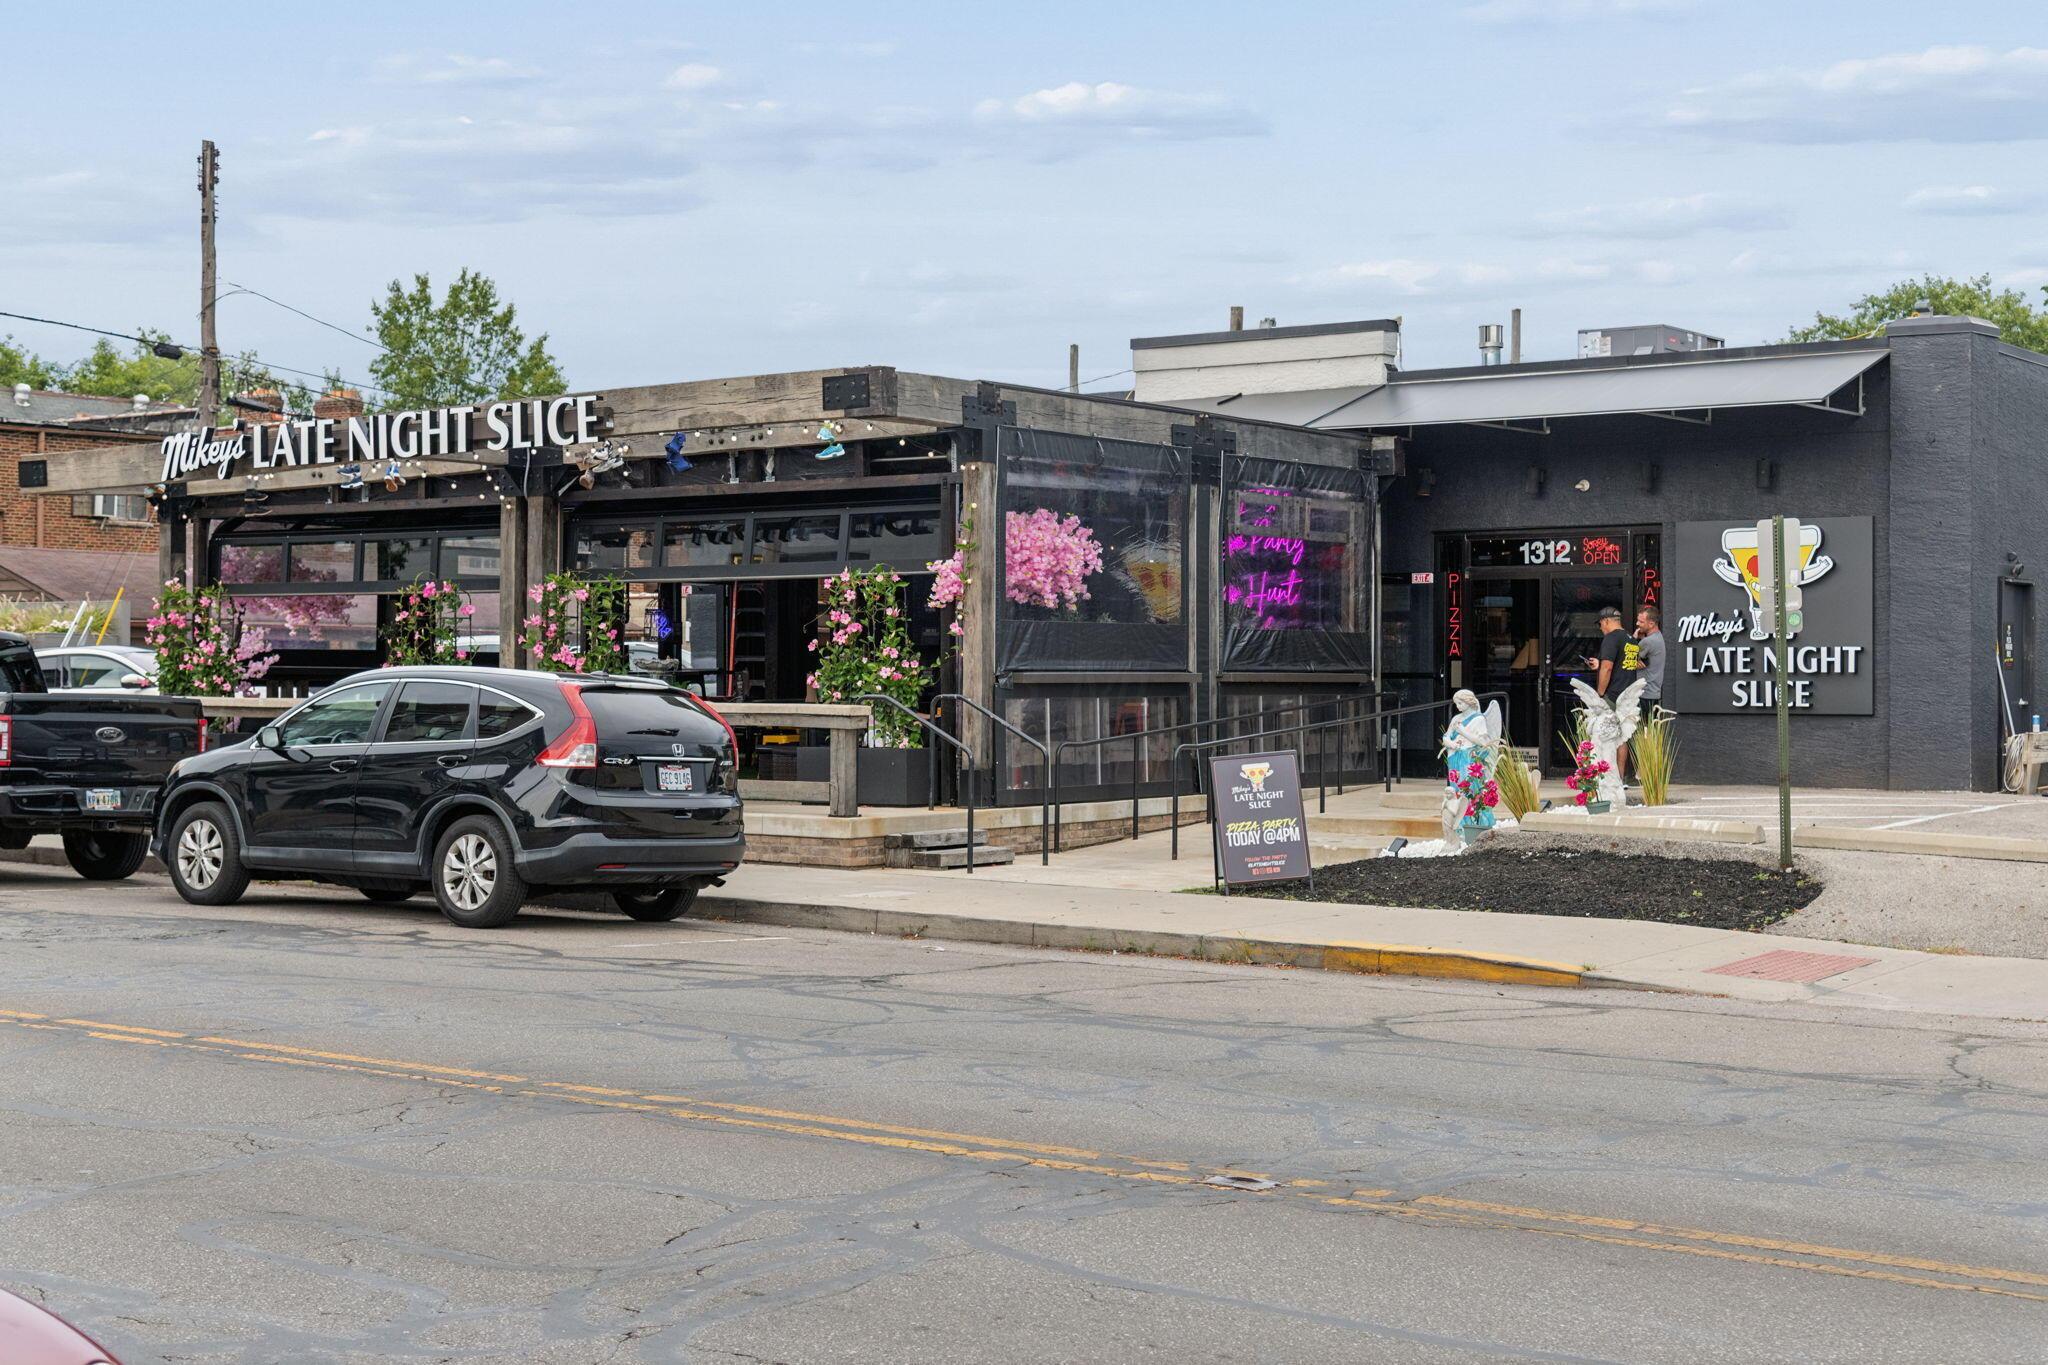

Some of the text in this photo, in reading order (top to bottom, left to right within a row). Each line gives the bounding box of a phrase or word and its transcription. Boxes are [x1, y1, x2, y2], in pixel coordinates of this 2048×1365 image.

[161, 395, 599, 482] Mikey's LATE NIGHT SLICE
[1519, 540, 1571, 565] 1312
[1584, 551, 1620, 565] OPEN
[1245, 569, 1304, 617] Hunt
[1449, 573, 1461, 657] PIZZA
[1678, 609, 1745, 643] Mikey's
[1686, 646, 1862, 674] LATE NIGHT
[1234, 790, 1284, 802] LATE NIGHT
[1248, 800, 1272, 809] SLICE
[1226, 827, 1301, 847] TODAY @4PM
